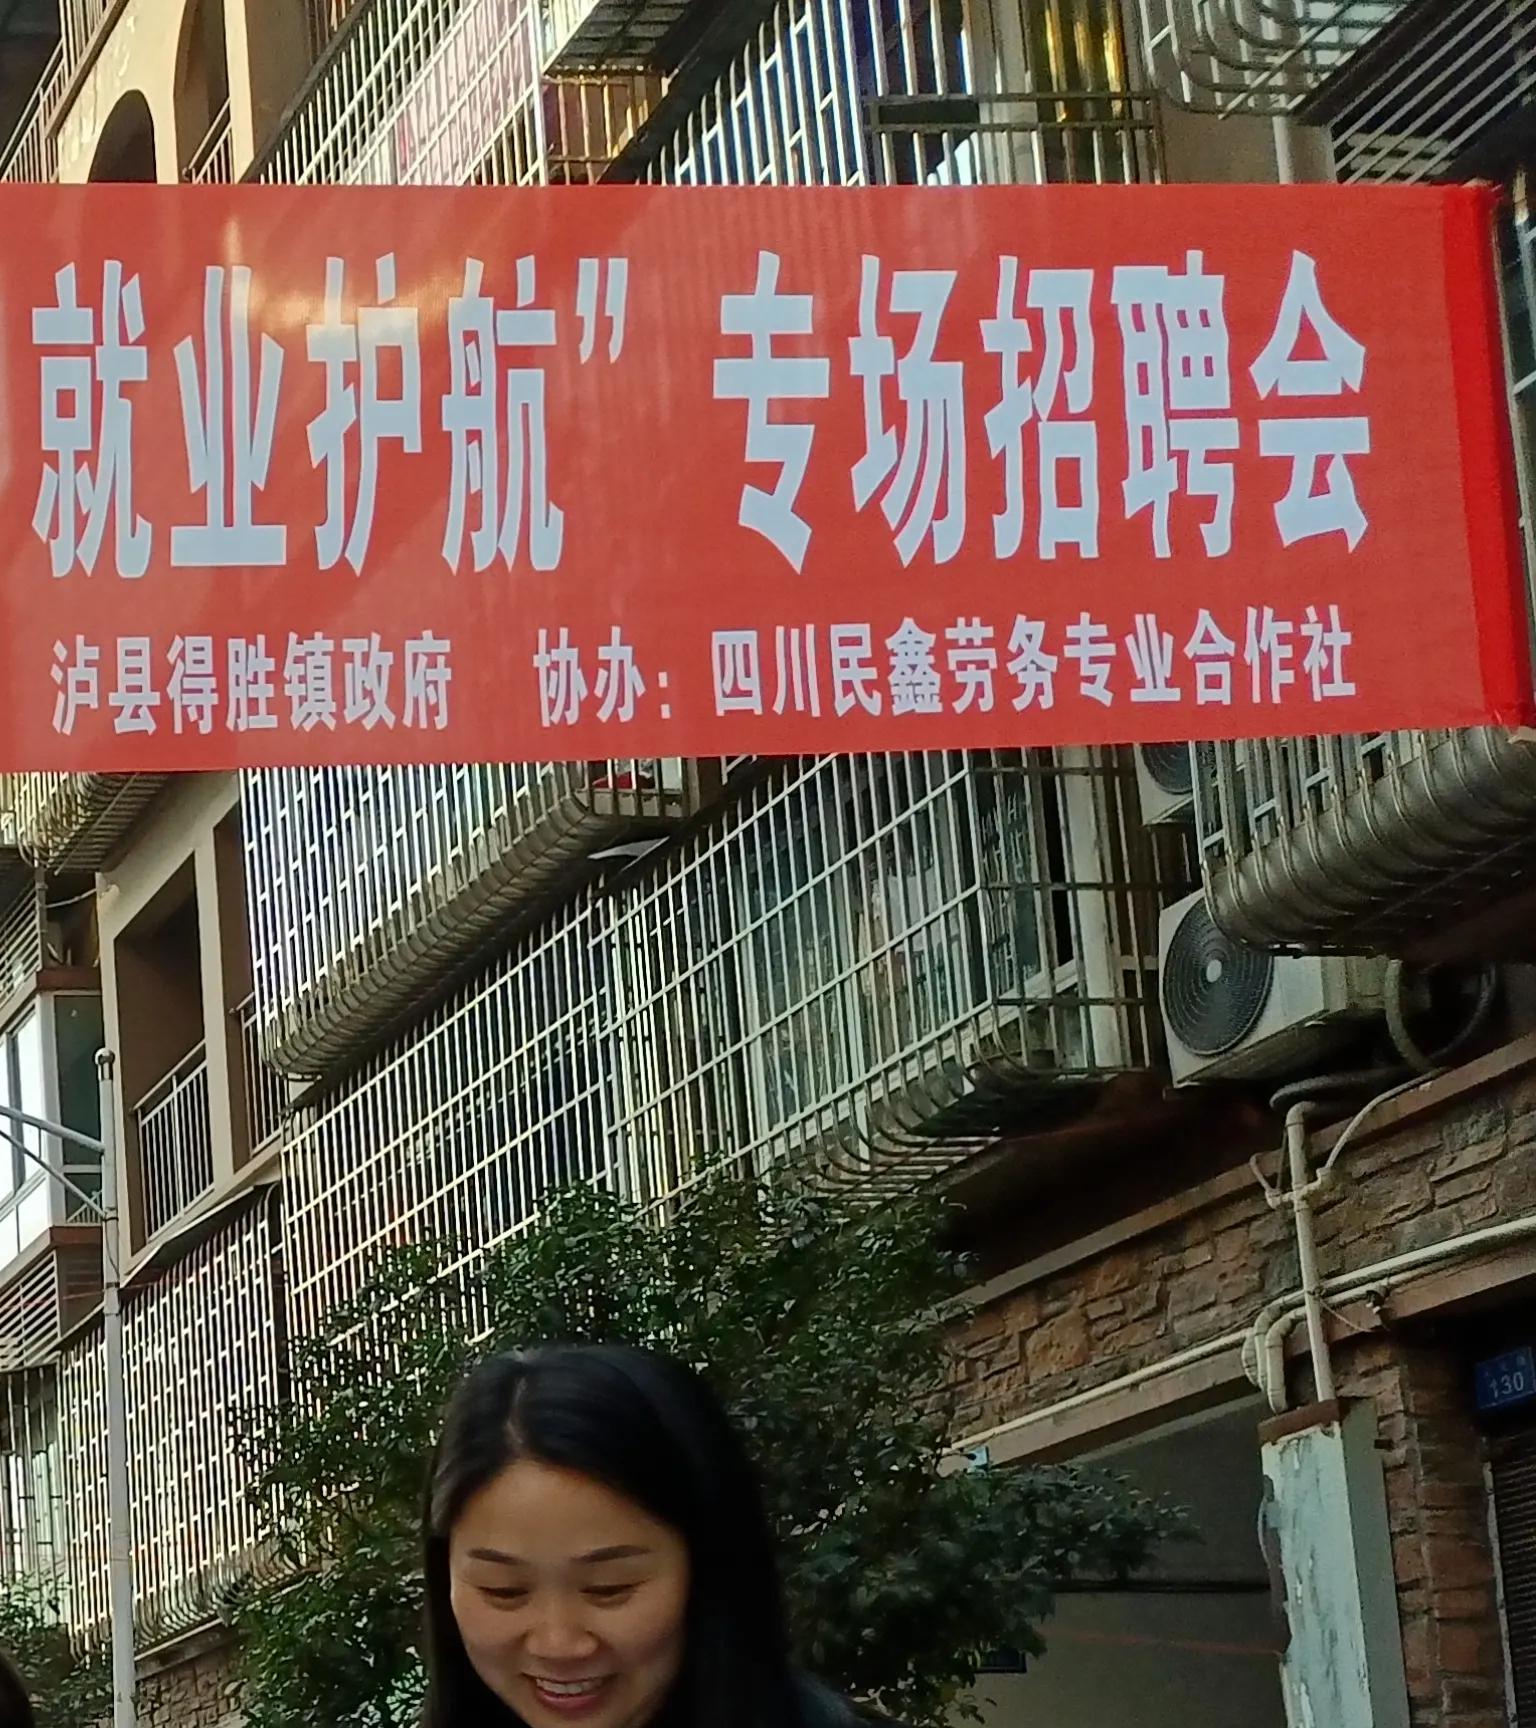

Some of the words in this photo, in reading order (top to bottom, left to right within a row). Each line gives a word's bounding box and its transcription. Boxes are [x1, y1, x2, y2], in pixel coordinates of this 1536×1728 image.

[710, 247, 1373, 576] 专场招聘会
[52, 628, 455, 738] 泸县得胜镇政府
[710, 603, 1358, 721] 四川民鑫劳务专业合作社
[1489, 1371, 1524, 1399] 130
